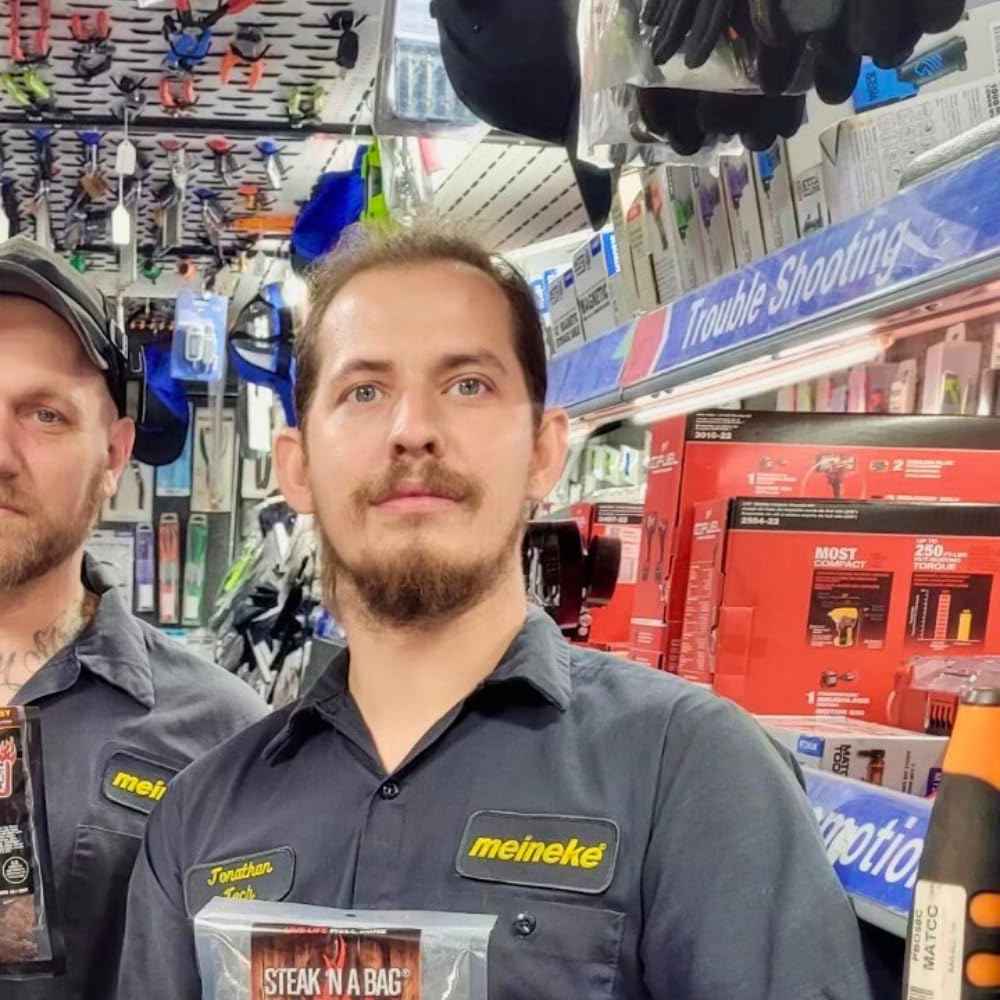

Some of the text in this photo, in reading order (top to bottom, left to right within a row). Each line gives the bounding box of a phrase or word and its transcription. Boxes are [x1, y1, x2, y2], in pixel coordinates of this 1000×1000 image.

[682, 271, 768, 350] Trouble
[767, 218, 911, 316] Shooting
[815, 547, 858, 561] MOST
[914, 543, 944, 557] 250
[813, 560, 867, 569] COMPACT
[468, 834, 607, 869] meineke
[207, 861, 273, 886] Jonathan
[264, 967, 322, 995] STEAK
[346, 968, 361, 996] A
